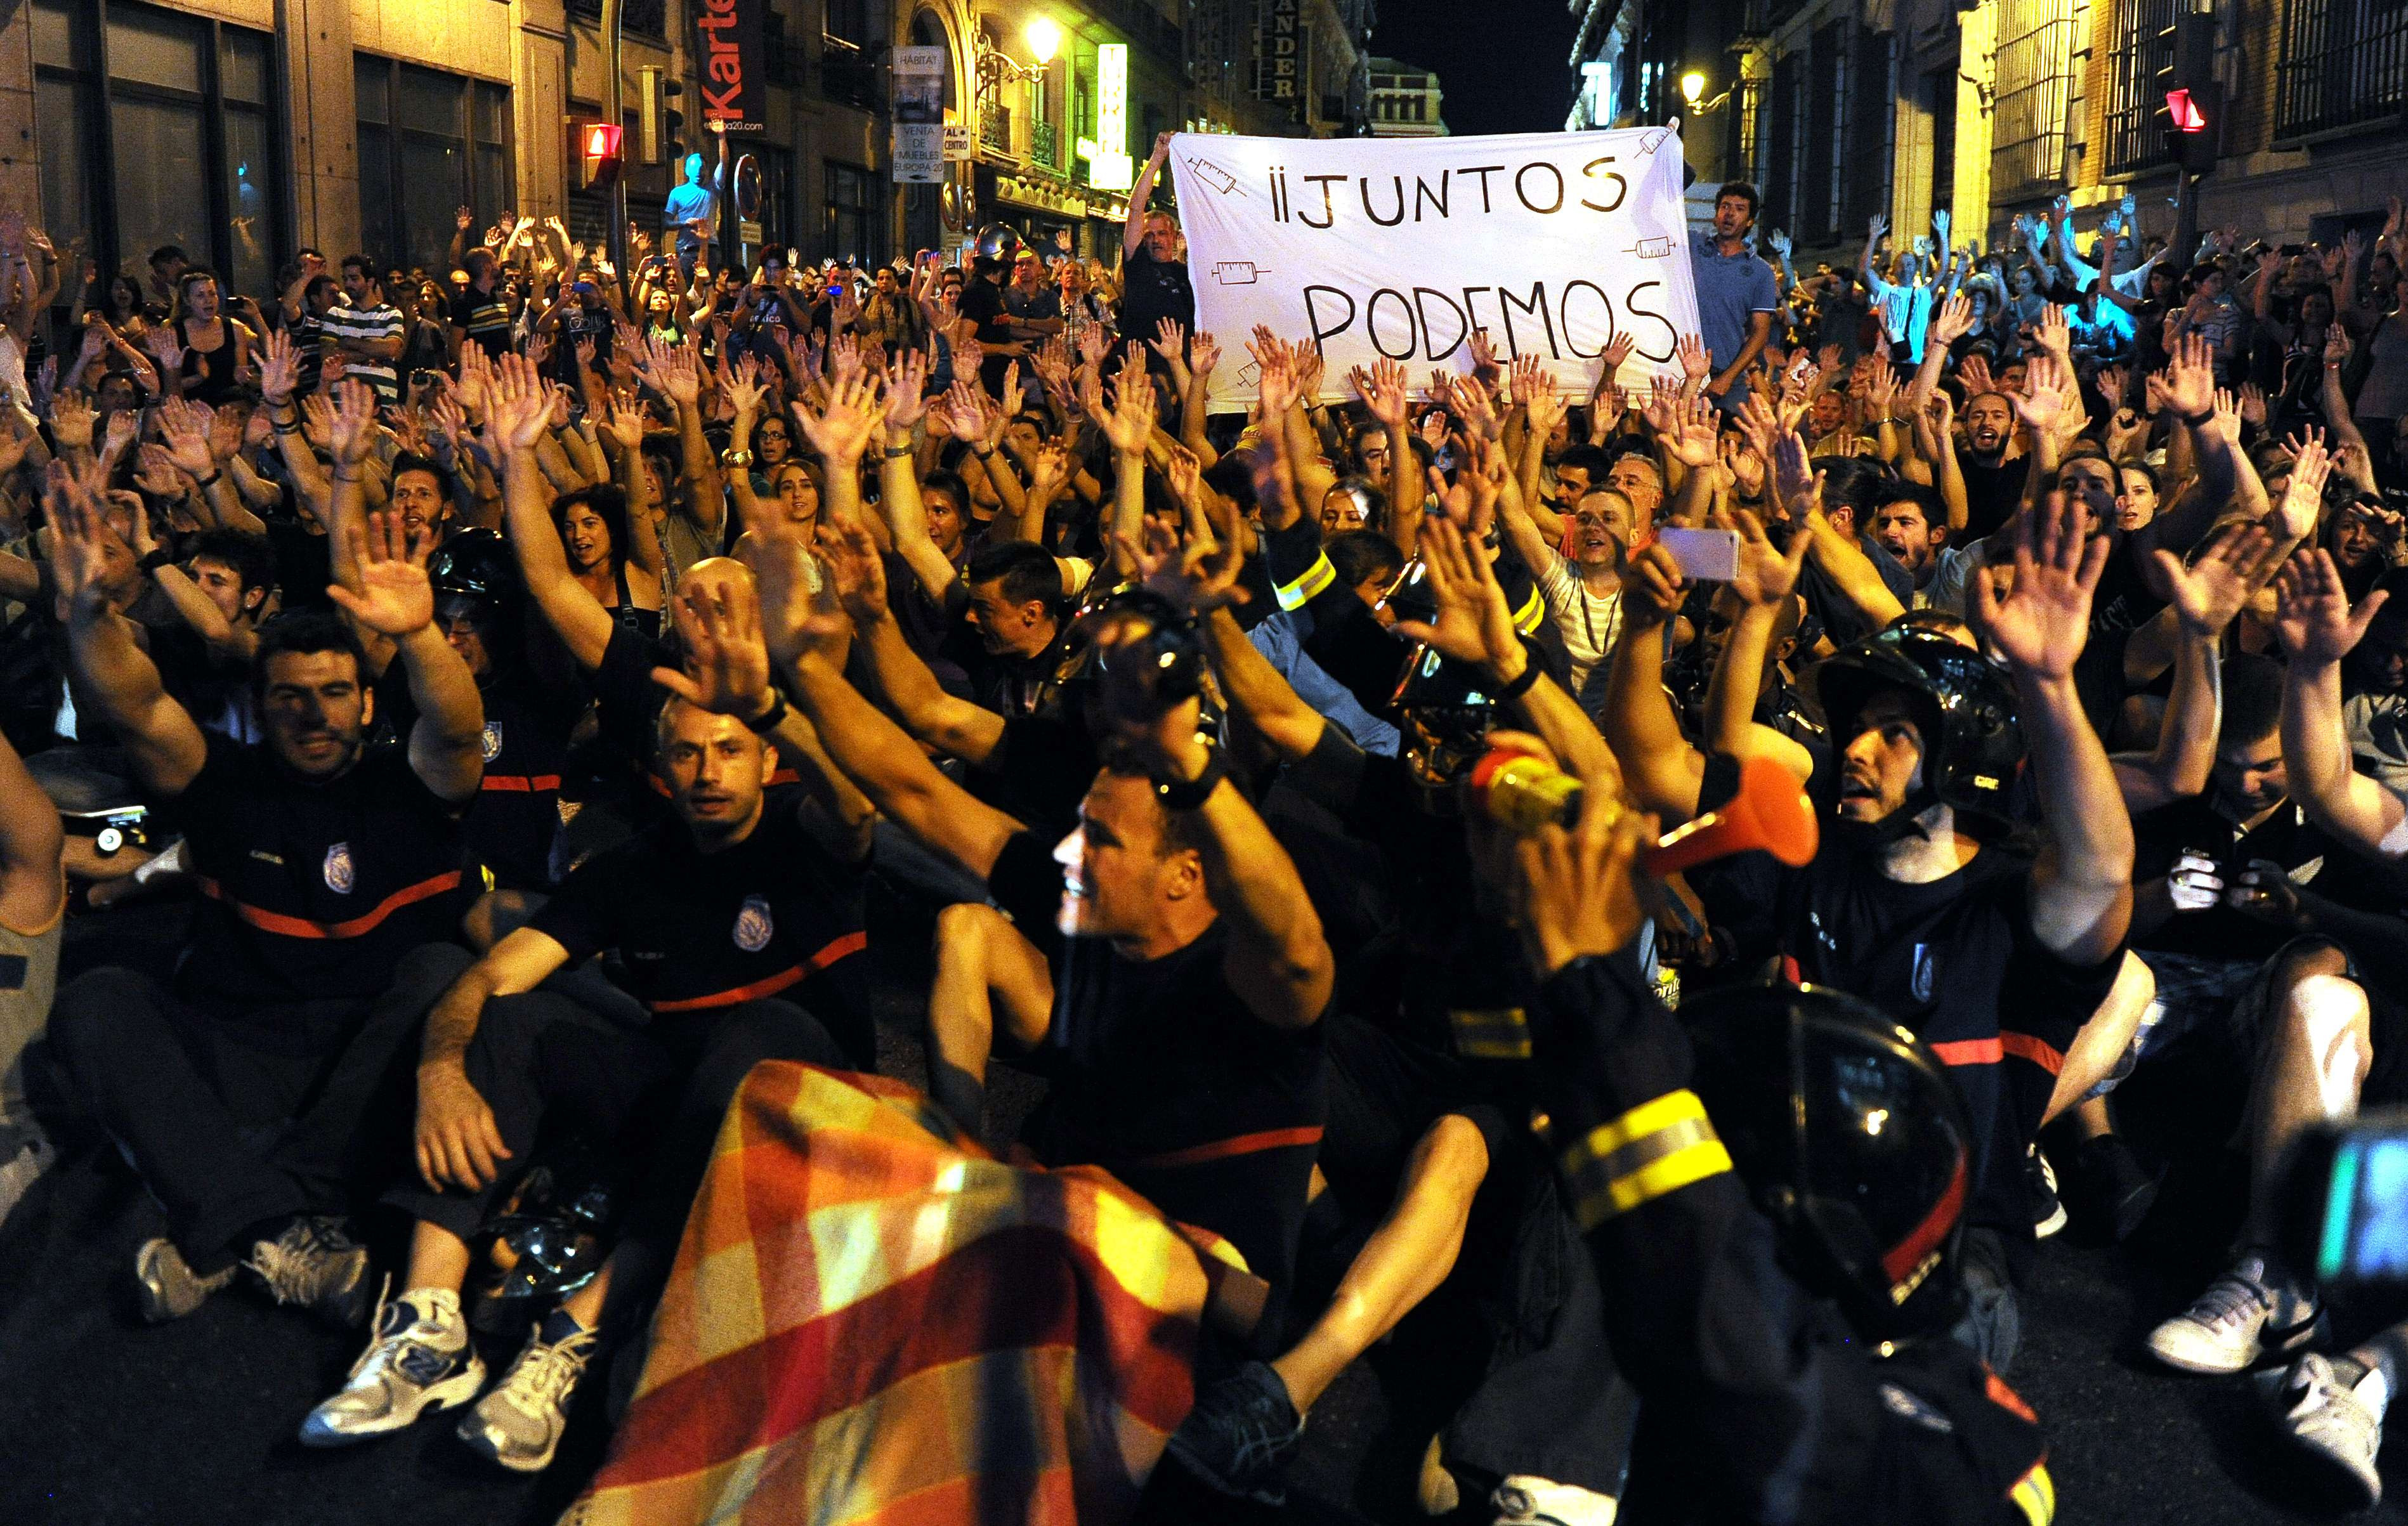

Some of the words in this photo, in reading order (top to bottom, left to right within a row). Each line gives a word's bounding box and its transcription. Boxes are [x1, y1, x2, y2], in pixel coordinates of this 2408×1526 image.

[903, 126, 934, 136] VENTA
[913, 139, 926, 148] DE
[945, 140, 967, 150] CENTRO
[898, 151, 939, 160] MUEBLES
[894, 162, 931, 171] EUROPA
[933, 163, 943, 172] 20
[1303, 280, 1678, 365] PODEMOS
